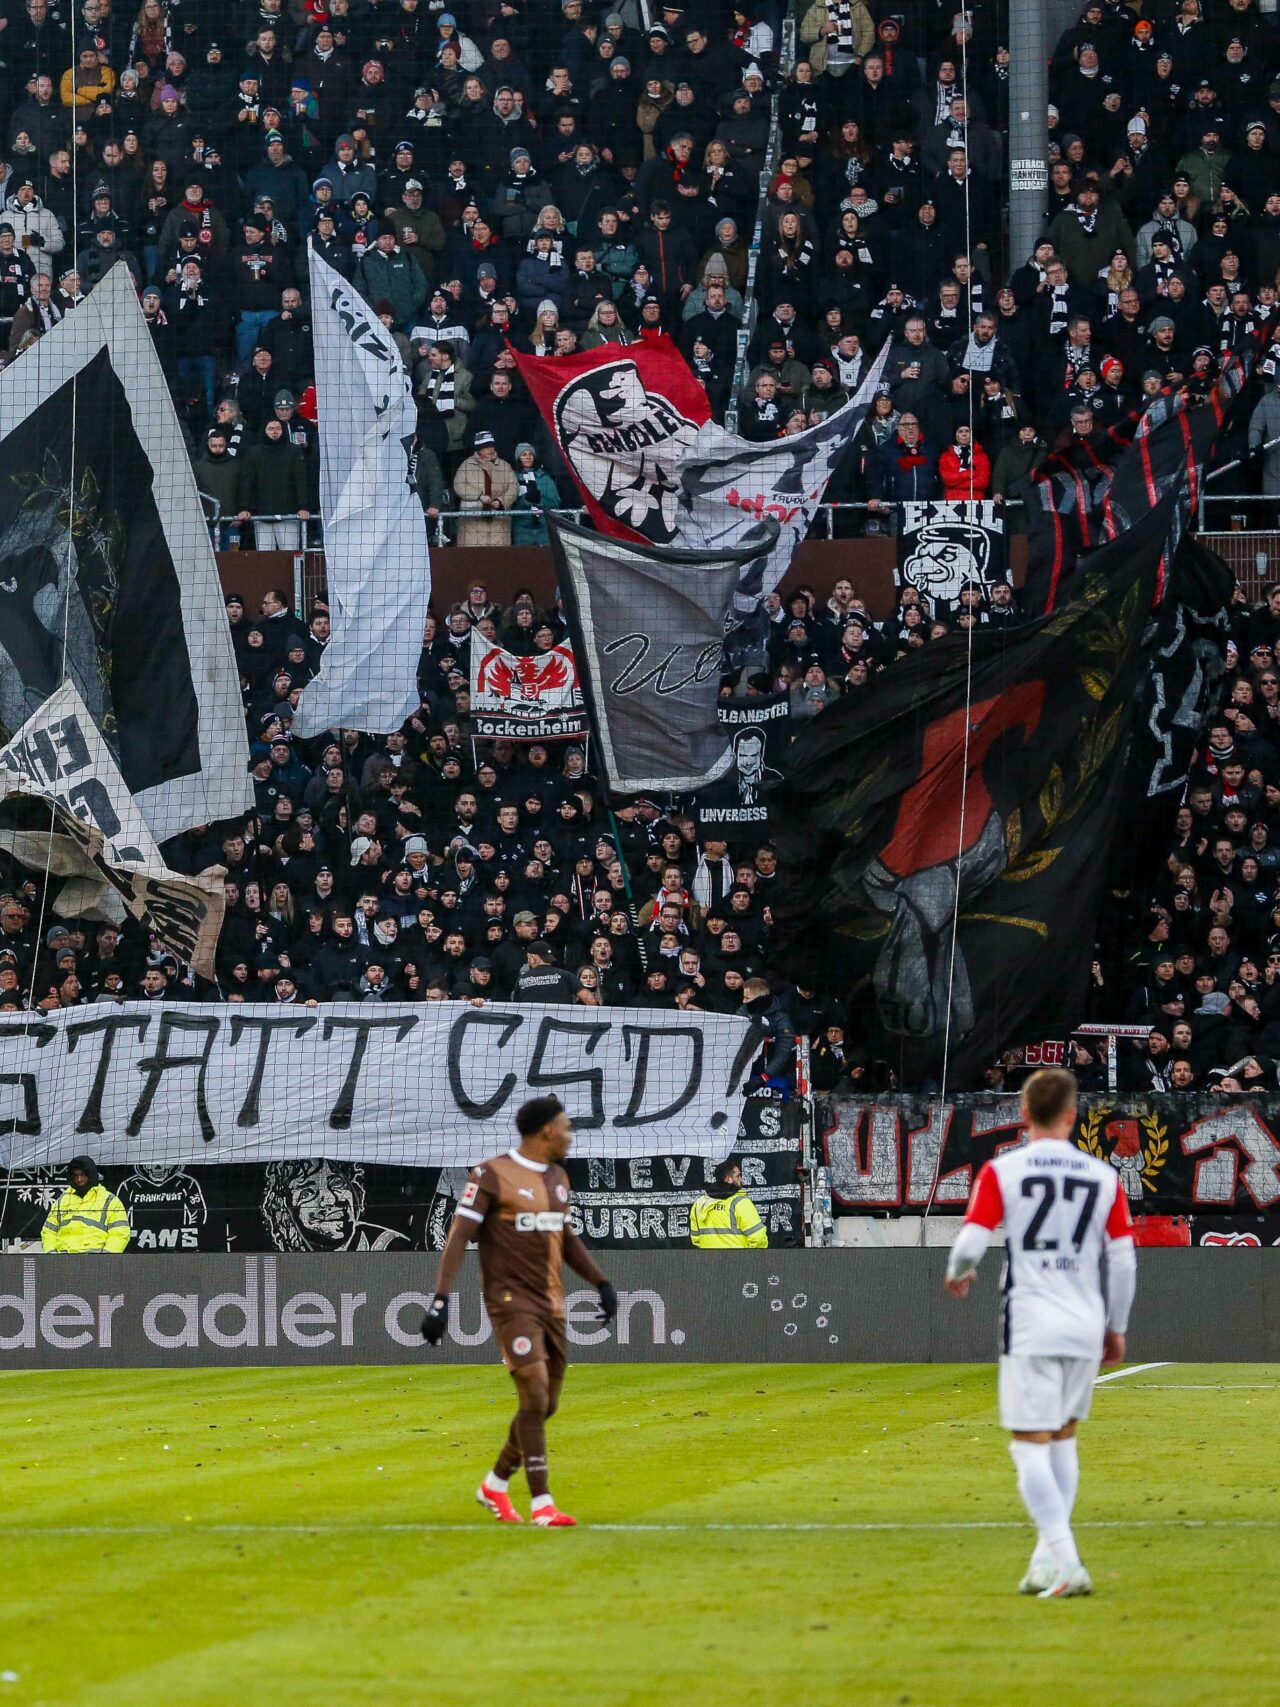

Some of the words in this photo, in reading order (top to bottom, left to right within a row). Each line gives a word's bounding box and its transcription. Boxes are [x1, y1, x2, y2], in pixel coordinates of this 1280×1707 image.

[903, 500, 1003, 536] EXIL
[448, 1011, 770, 1131] CSD!
[1021, 1175, 1100, 1254] 27
[142, 1255, 368, 1349] adler
[384, 1289, 687, 1347] auen.
